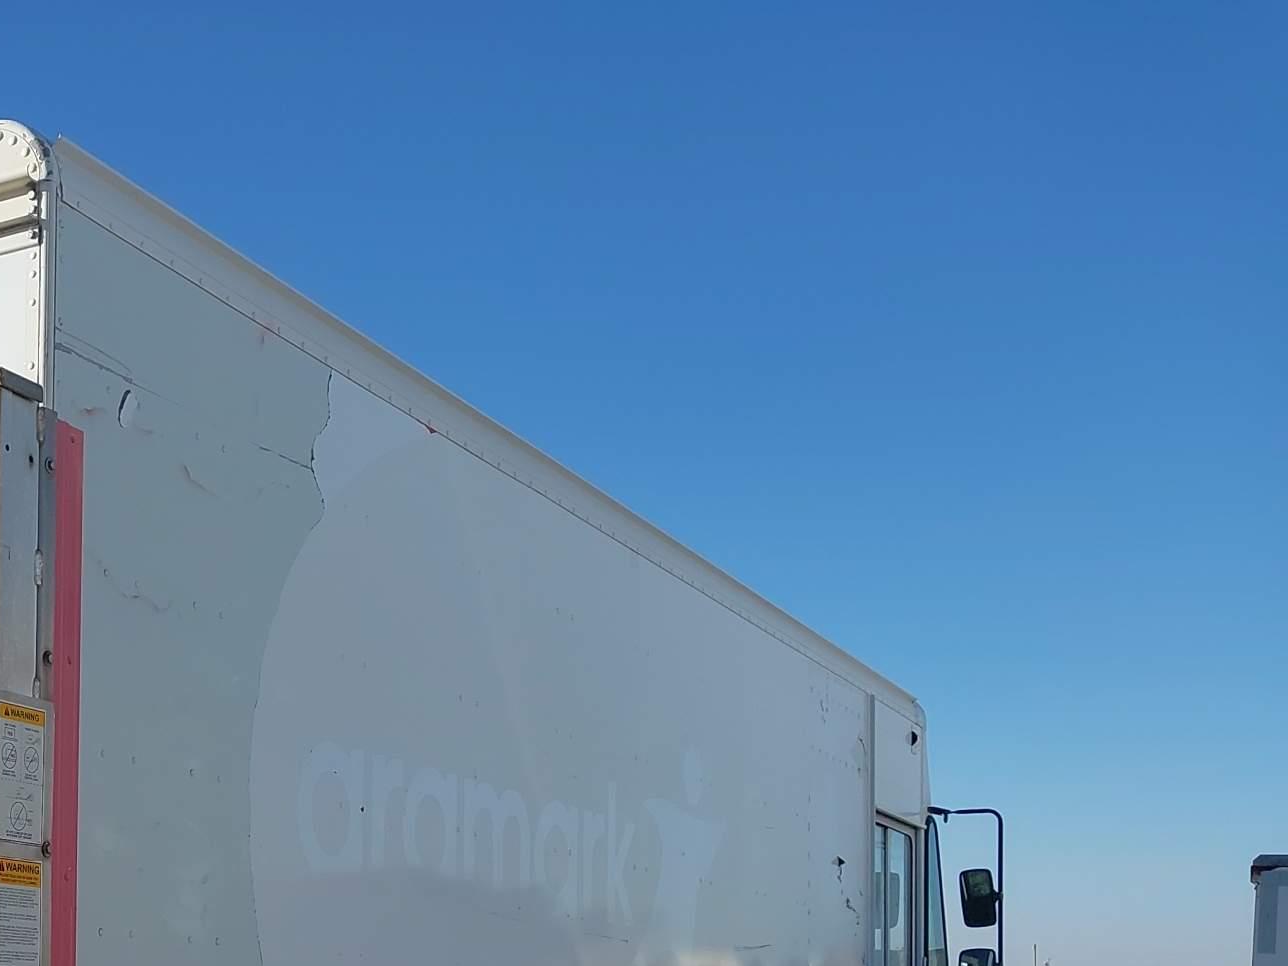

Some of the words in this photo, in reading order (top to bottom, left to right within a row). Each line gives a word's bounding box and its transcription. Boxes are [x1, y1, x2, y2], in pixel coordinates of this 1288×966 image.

[10, 708, 40, 722] WARNING
[298, 740, 635, 926] aramark
[5, 862, 40, 875] WARNING
